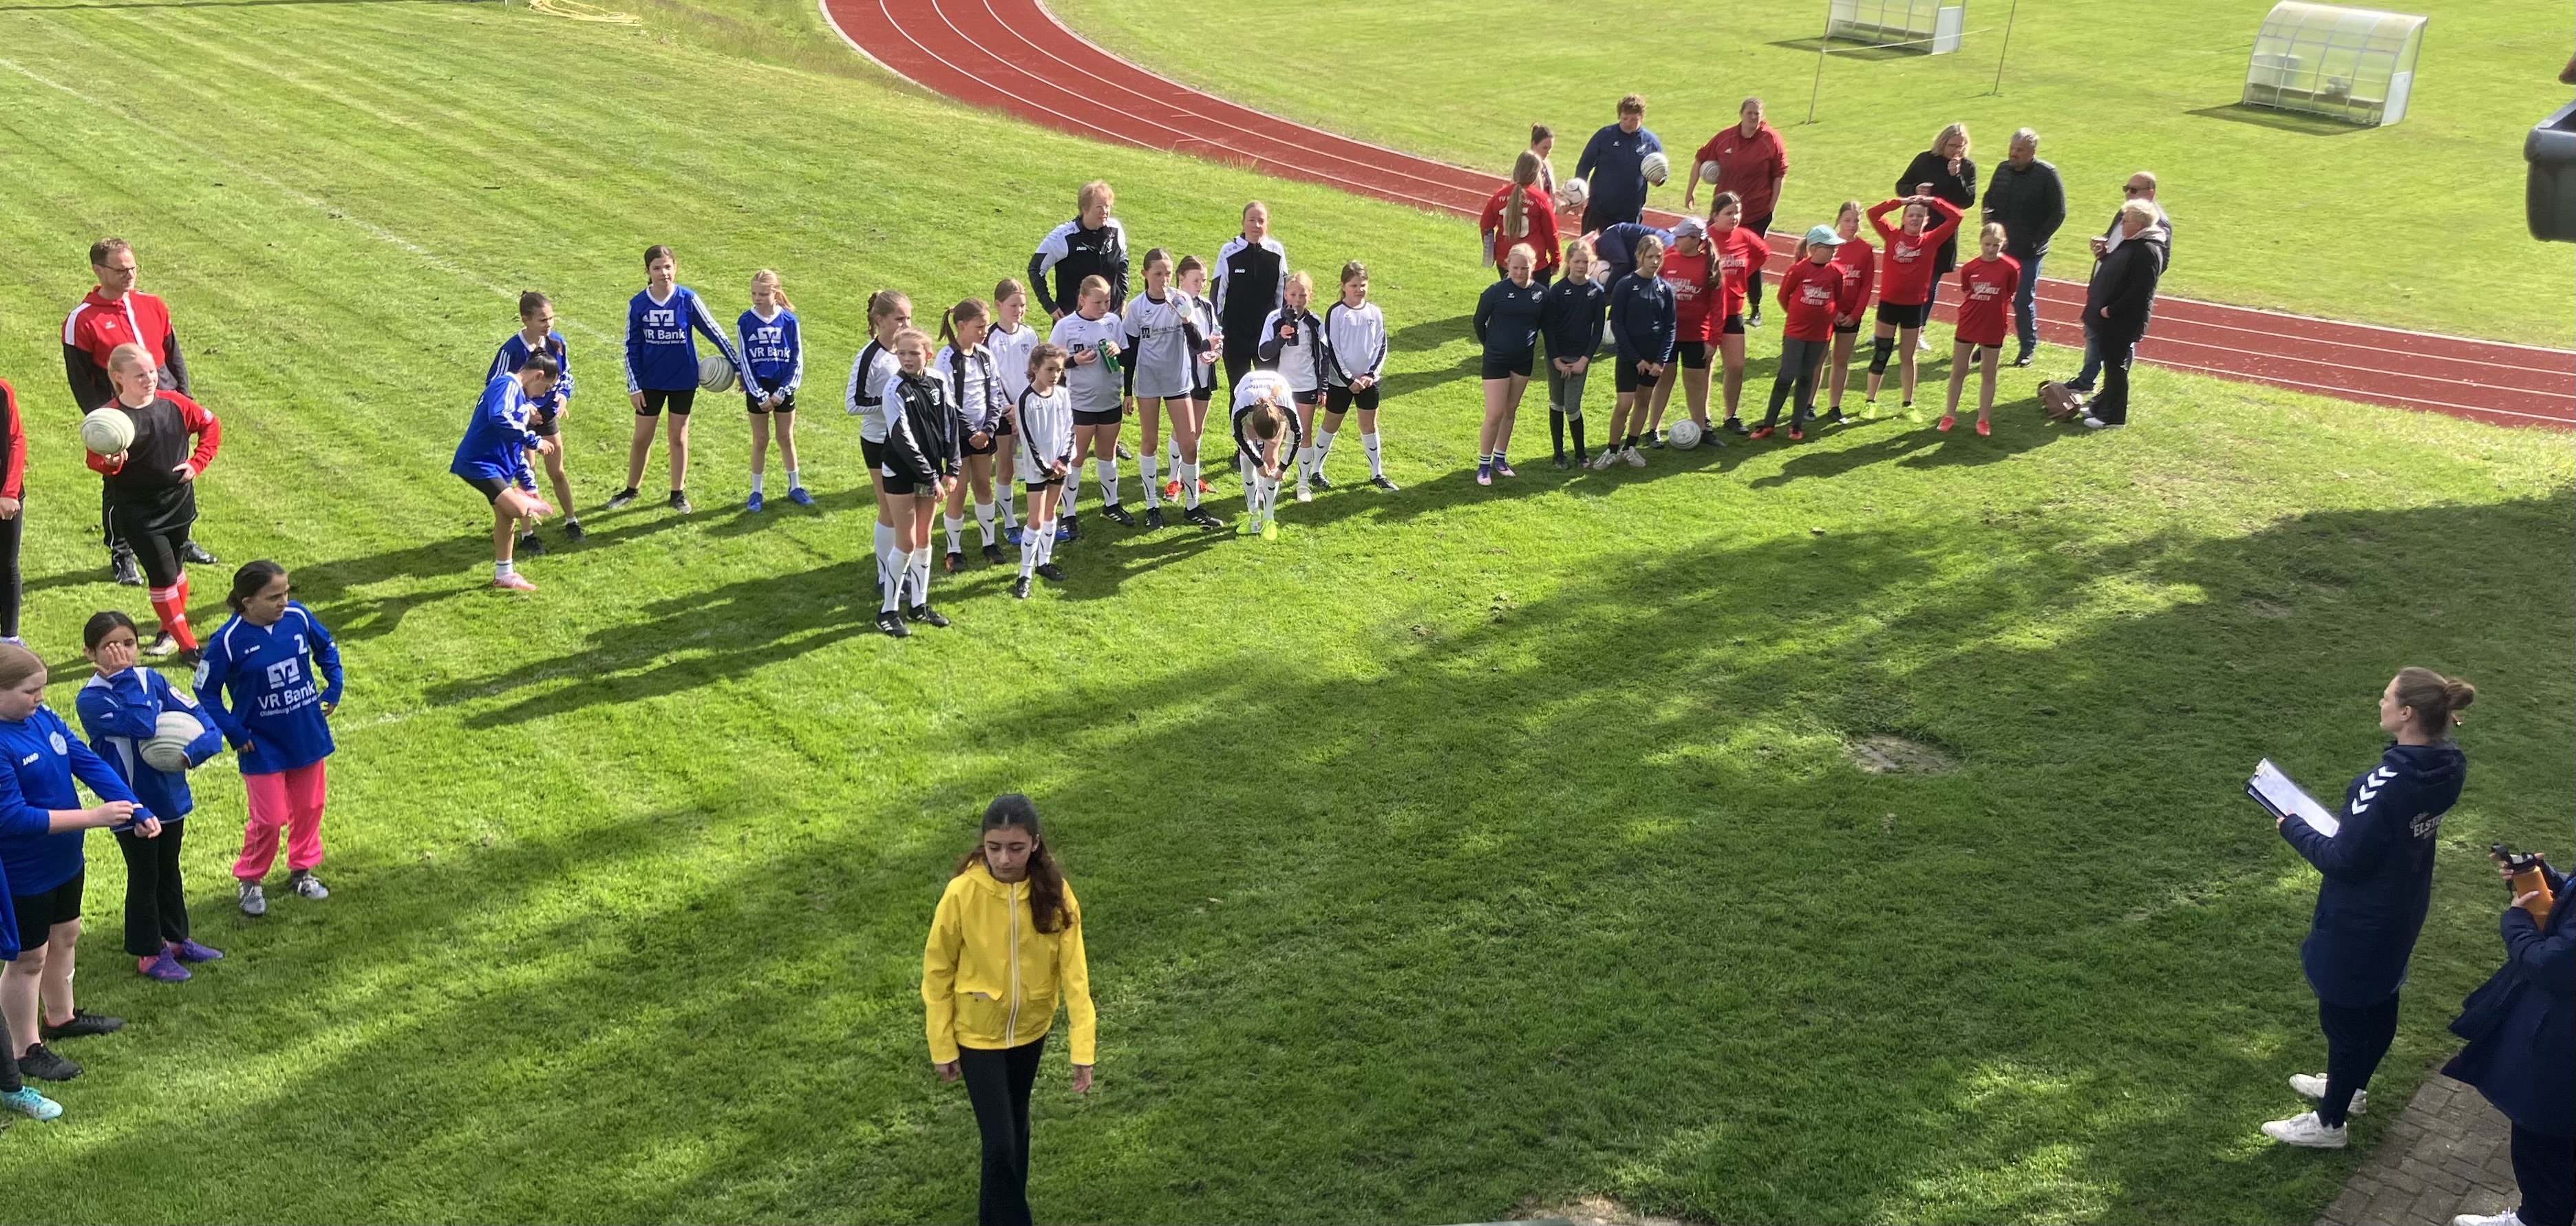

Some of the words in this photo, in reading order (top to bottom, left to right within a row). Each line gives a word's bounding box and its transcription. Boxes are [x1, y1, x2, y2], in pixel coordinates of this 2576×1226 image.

[643, 328, 654, 339] VR
[657, 328, 685, 339] Bank
[749, 347, 765, 358] VR
[767, 346, 791, 358] Bank
[294, 633, 308, 655] 2
[257, 693, 281, 710] VR
[284, 680, 315, 706] Bank
[23, 752, 39, 766] JAKO
[2414, 814, 2442, 838] ELSTE
